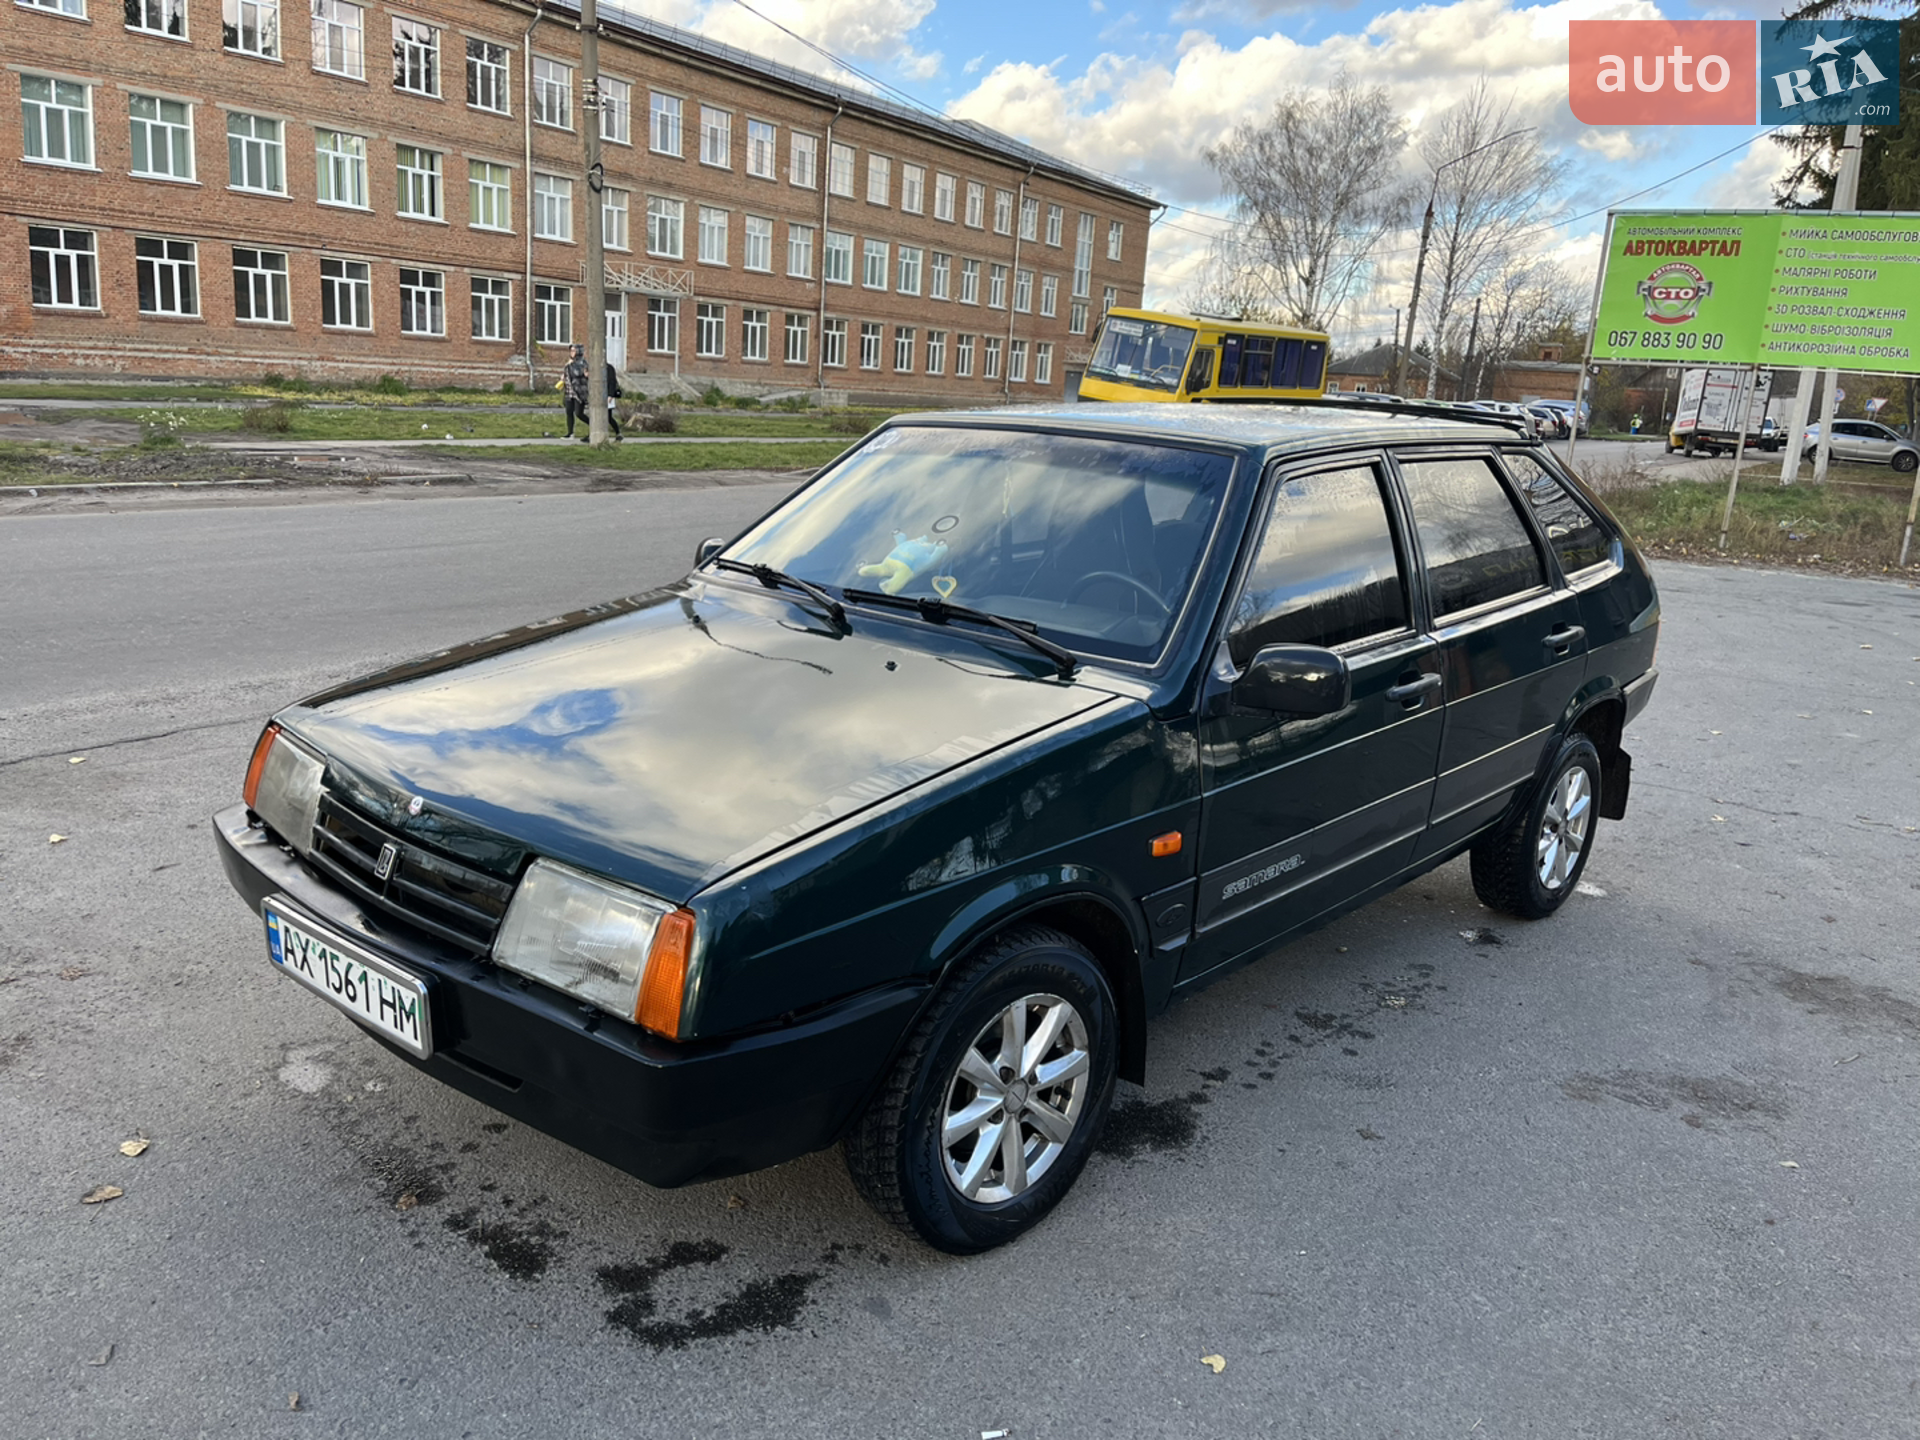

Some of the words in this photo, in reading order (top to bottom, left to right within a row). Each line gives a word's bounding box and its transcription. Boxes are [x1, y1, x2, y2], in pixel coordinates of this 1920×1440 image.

[1627, 226, 1695, 236] АВТОМОБІЛЬНИЙ
[1697, 227, 1743, 236] КОМПЛЕКС
[1789, 227, 1828, 240] МИЙКА
[1830, 229, 1920, 243] САМООБСЛУГОВ
[1623, 239, 1742, 257] АВТОКВАРТАЛ
[1785, 247, 1806, 258] СТО
[1782, 266, 1831, 278] МАЛЯРНІ
[1833, 268, 1877, 280] РОБОТИ
[1653, 287, 1695, 299] СТО
[1778, 285, 1848, 297] РИХТУВАННЯ
[1774, 304, 1788, 314] 3D
[1790, 305, 1906, 320] РОЗВАЛ-СХОДЖЕННЯ
[1608, 330, 1637, 347] 067
[1641, 331, 1672, 349] 883
[1676, 332, 1697, 349] 90
[1702, 333, 1724, 350] 90
[1768, 341, 1856, 355] АНТИКОРОЗІЙНА
[1859, 345, 1910, 358] ОБРОБКА
[317, 946, 371, 1013] 1561
